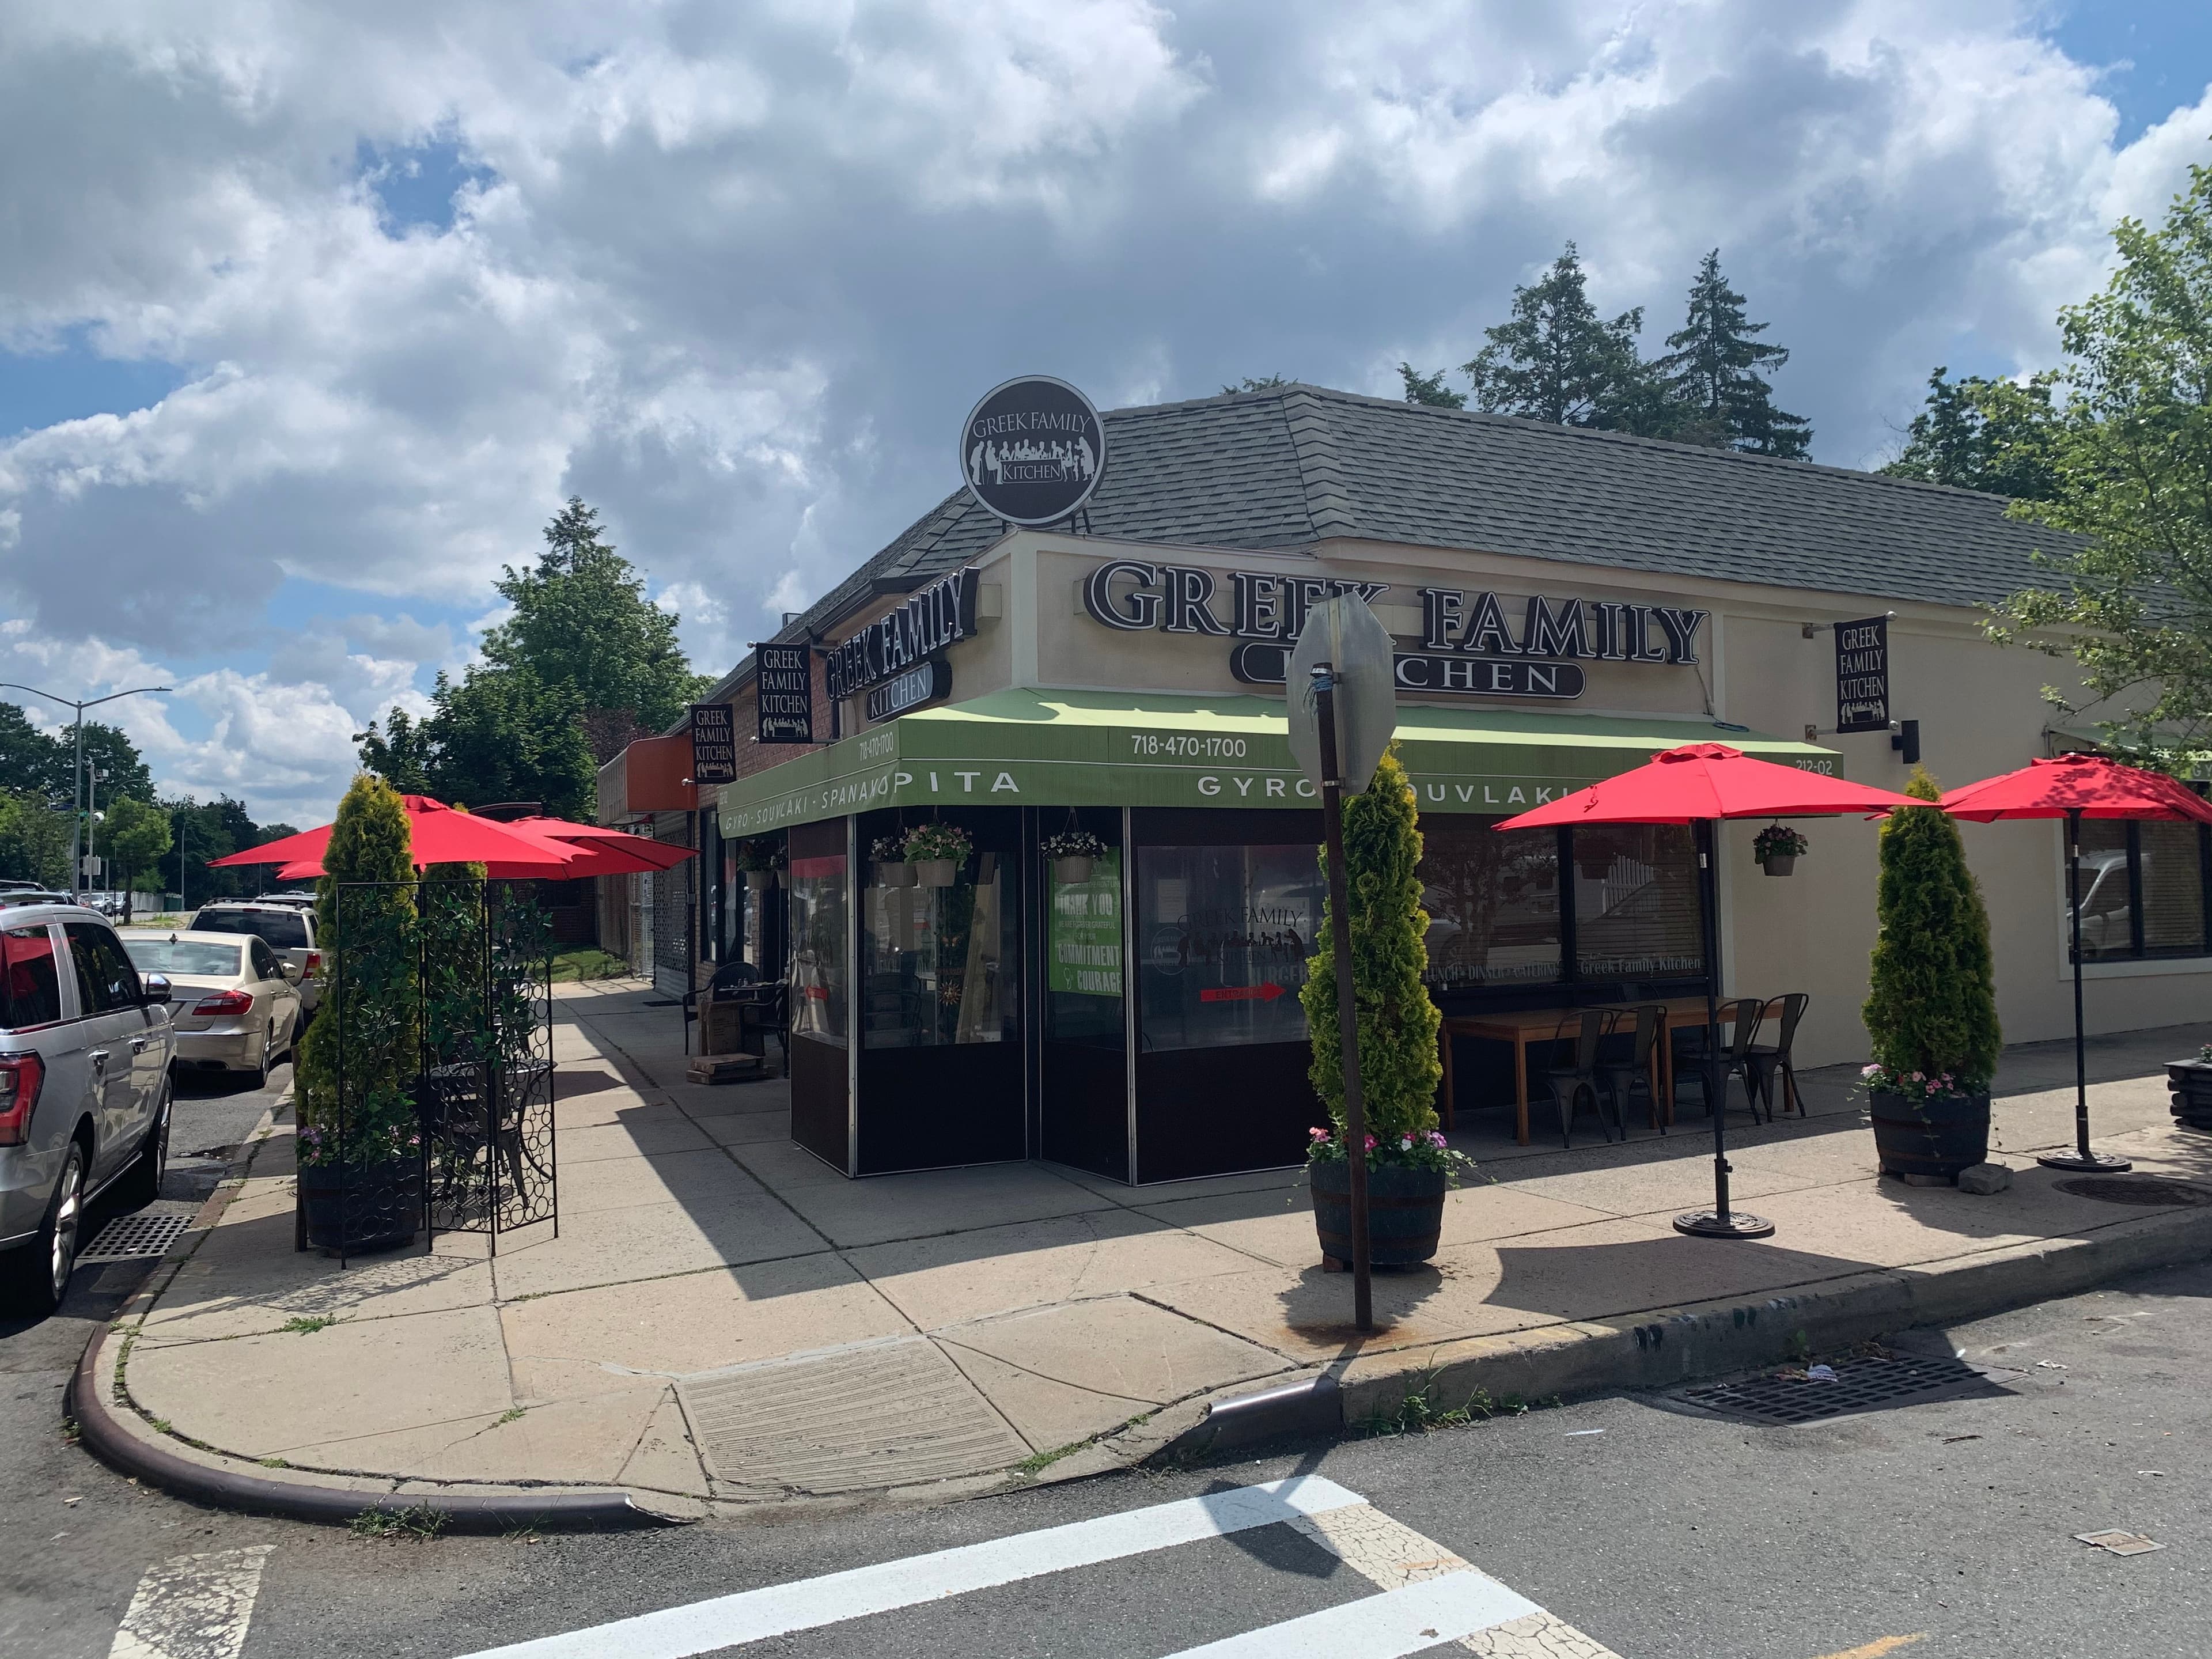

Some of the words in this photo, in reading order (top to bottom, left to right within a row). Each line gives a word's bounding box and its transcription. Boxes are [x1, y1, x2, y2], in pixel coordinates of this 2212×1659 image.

[973, 412, 1027, 438] GREEK
[1031, 412, 1092, 433] FAMILY
[1003, 464, 1060, 480] KITCHEN
[825, 625, 878, 702] GREEK
[881, 567, 979, 675] FAMILY
[1421, 588, 1710, 664] FAMILY
[1842, 626, 1880, 650] GREEK
[764, 649, 802, 669] GREEK
[1840, 650, 1883, 674] FAMILY
[762, 672, 806, 691] FAMILY
[870, 666, 927, 718] KITCHEN
[1840, 675, 1885, 700] KITCHEN
[762, 695, 807, 714] KITCHEN
[696, 710, 727, 726] GREEK
[695, 728, 730, 743] FAMILY
[1131, 735, 1247, 757] 718-470-1700
[696, 745, 732, 760] KITCHEN
[859, 732, 893, 762] 718-470-1700
[1796, 760, 1832, 775] 212-02
[1198, 777, 1317, 797] GYRO
[1407, 783, 1567, 804] UVLAKI
[726, 813, 748, 831] GYRO
[756, 797, 807, 824] SOUVLAKI
[1059, 893, 1088, 916] THANK
[1092, 894, 1113, 916] YOU
[1240, 907, 1303, 927] FAMILY
[1058, 944, 1120, 966] COMMITMENT
[1581, 959, 1615, 974] Greek
[1619, 957, 1654, 975] Family
[1659, 956, 1701, 971] Kitchen
[1077, 970, 1122, 994] COURAGE
[1426, 966, 1458, 982] LUNCH
